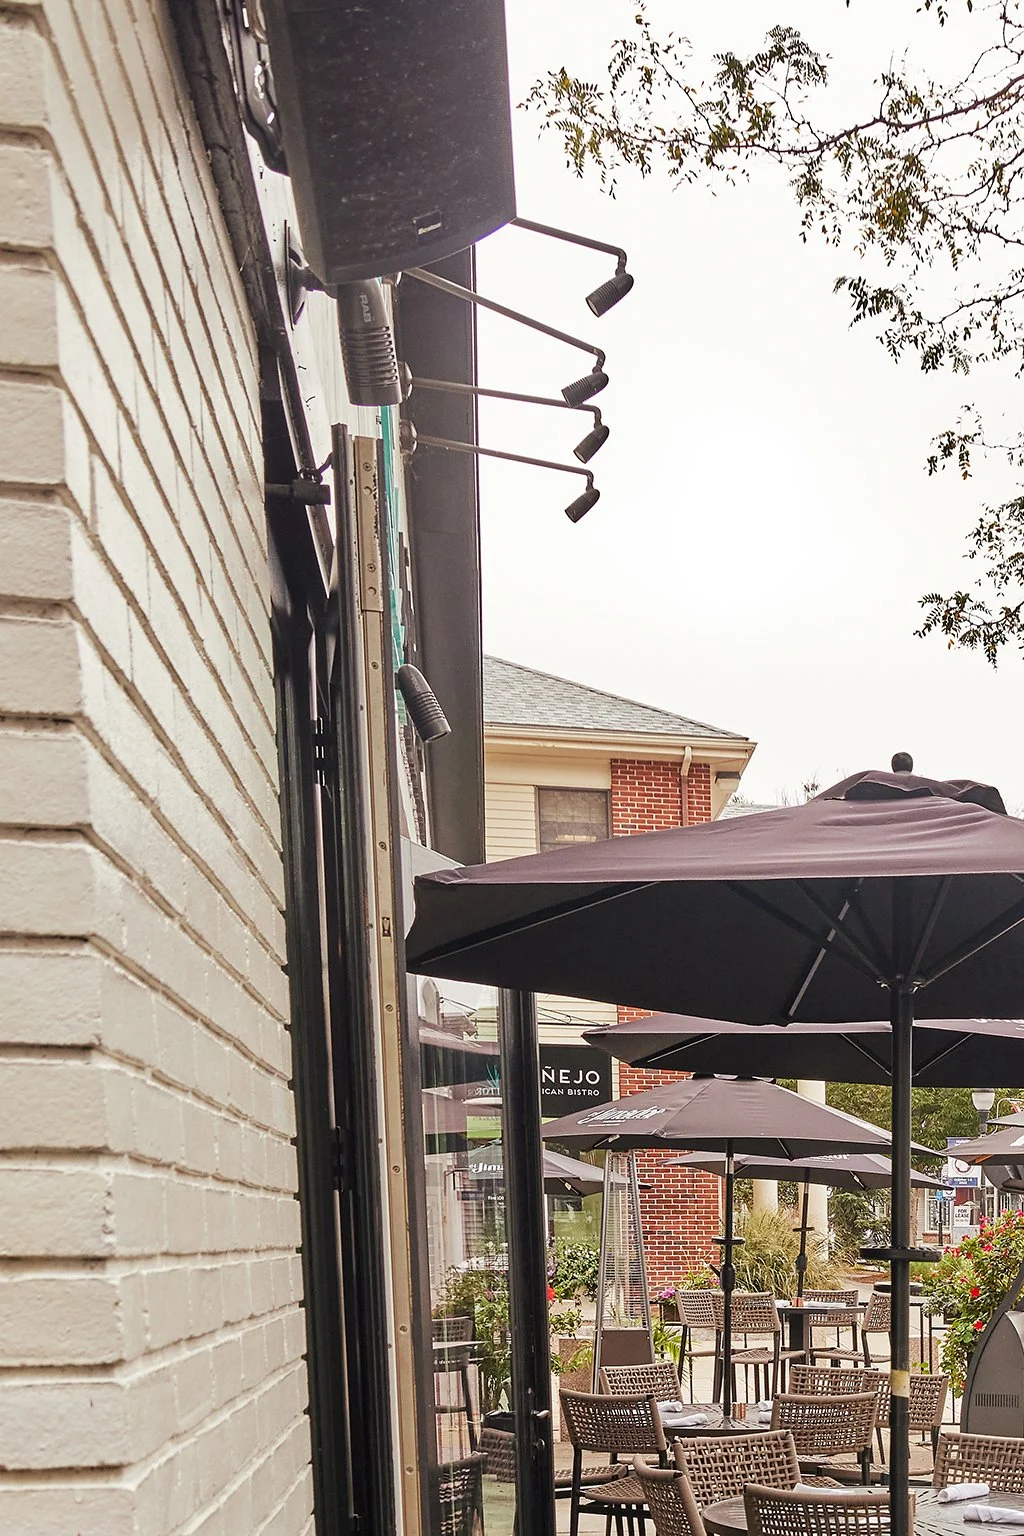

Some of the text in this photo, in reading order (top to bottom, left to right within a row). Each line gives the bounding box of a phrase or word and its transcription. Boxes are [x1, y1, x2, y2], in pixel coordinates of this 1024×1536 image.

[541, 1066, 600, 1085] ÑEJO
[541, 1088, 600, 1097] ICAN BISTRO
